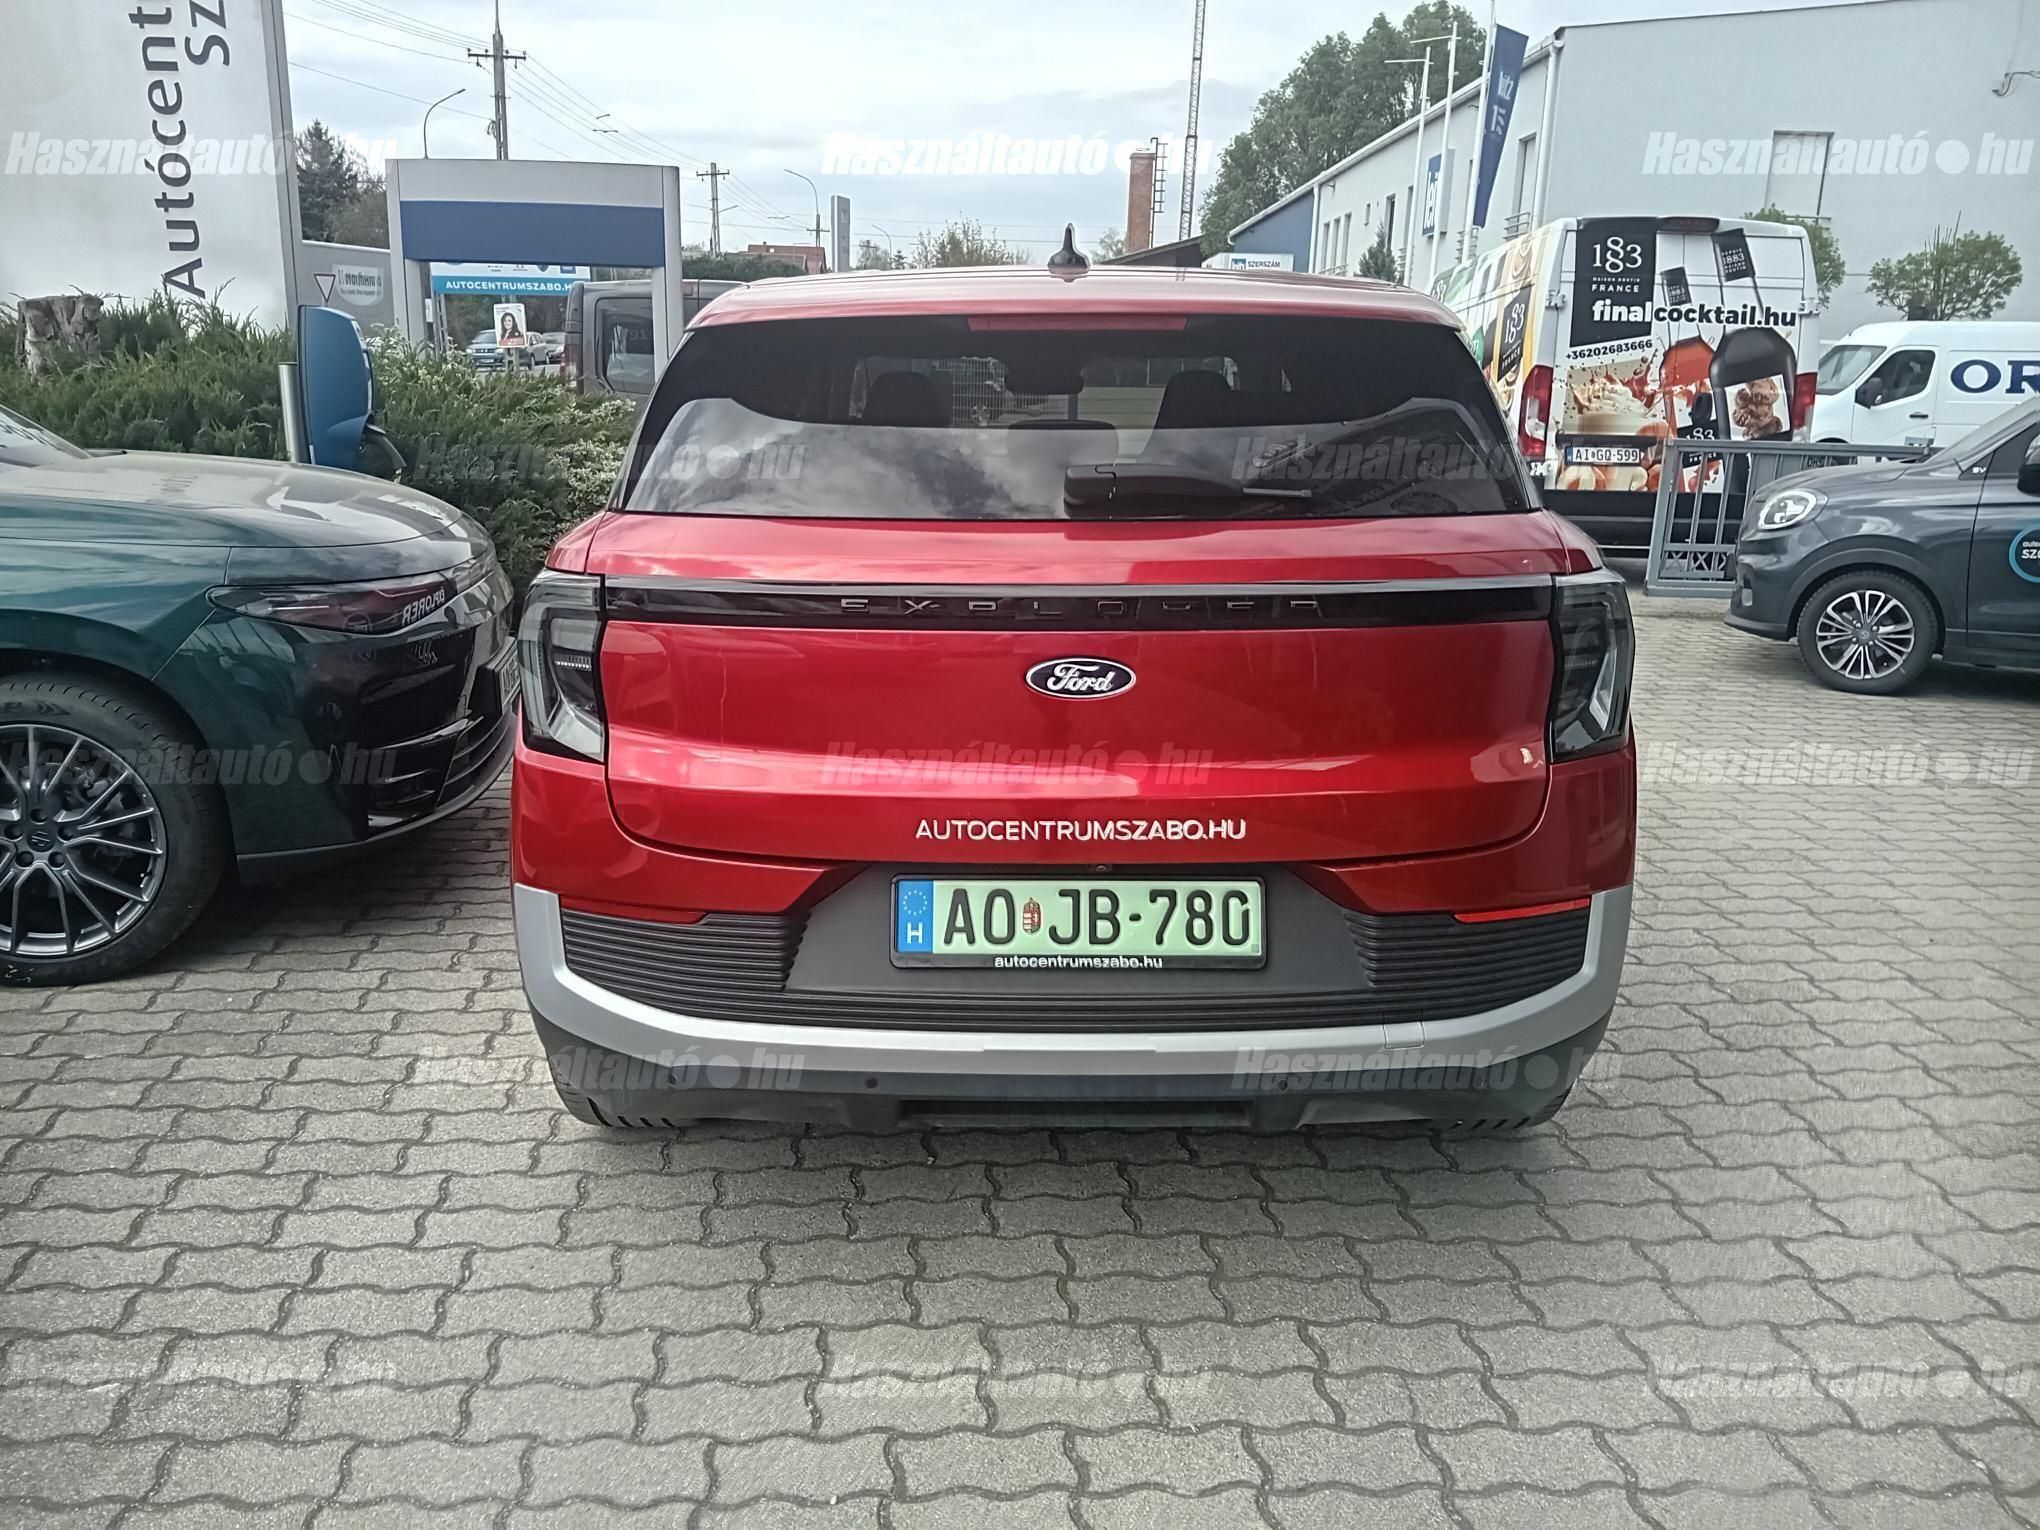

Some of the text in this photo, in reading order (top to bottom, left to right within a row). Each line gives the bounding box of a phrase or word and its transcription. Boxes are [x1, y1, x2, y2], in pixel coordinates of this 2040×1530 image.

[1591, 283, 1640, 293] FRANCE
[1566, 340, 1652, 360] +36202683666
[1596, 449, 1638, 462] GQ-599
[1047, 664, 1116, 691] Ford
[915, 818, 1247, 840] AUTOCENTRUMSZABO.HU
[905, 922, 924, 944] H
[994, 954, 1163, 969] autocentrumszabo.hu
